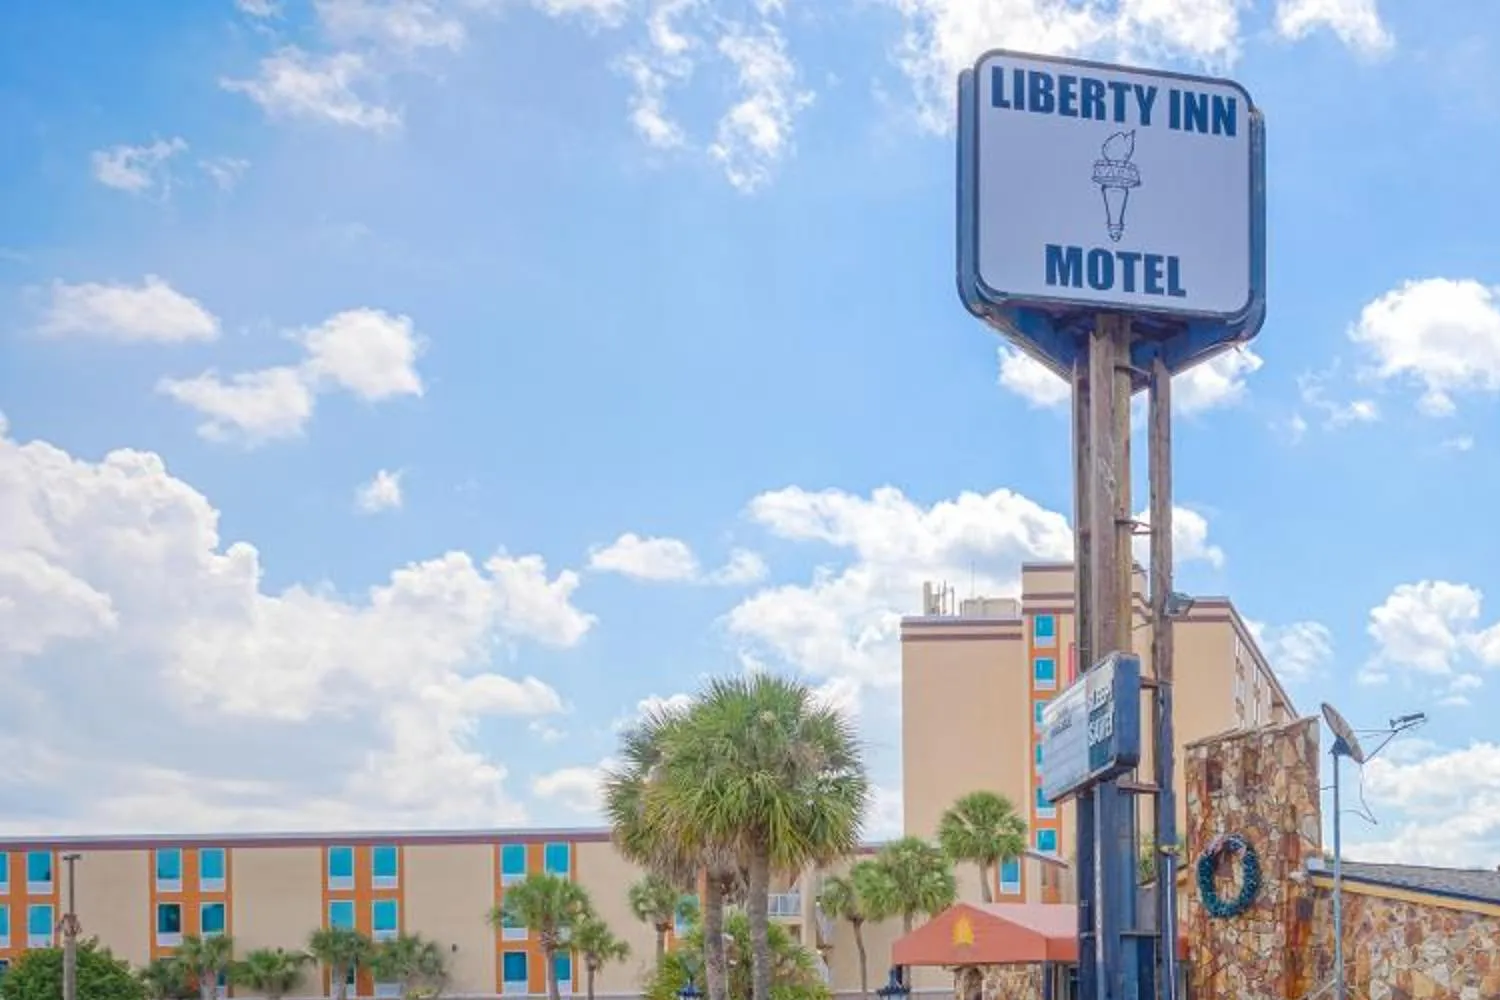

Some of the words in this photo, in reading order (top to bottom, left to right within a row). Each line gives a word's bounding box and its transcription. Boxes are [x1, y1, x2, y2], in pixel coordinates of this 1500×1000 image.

[992, 66, 1157, 126] LIBERTY
[1169, 89, 1236, 136] INN
[1045, 243, 1187, 297] MOTEL
